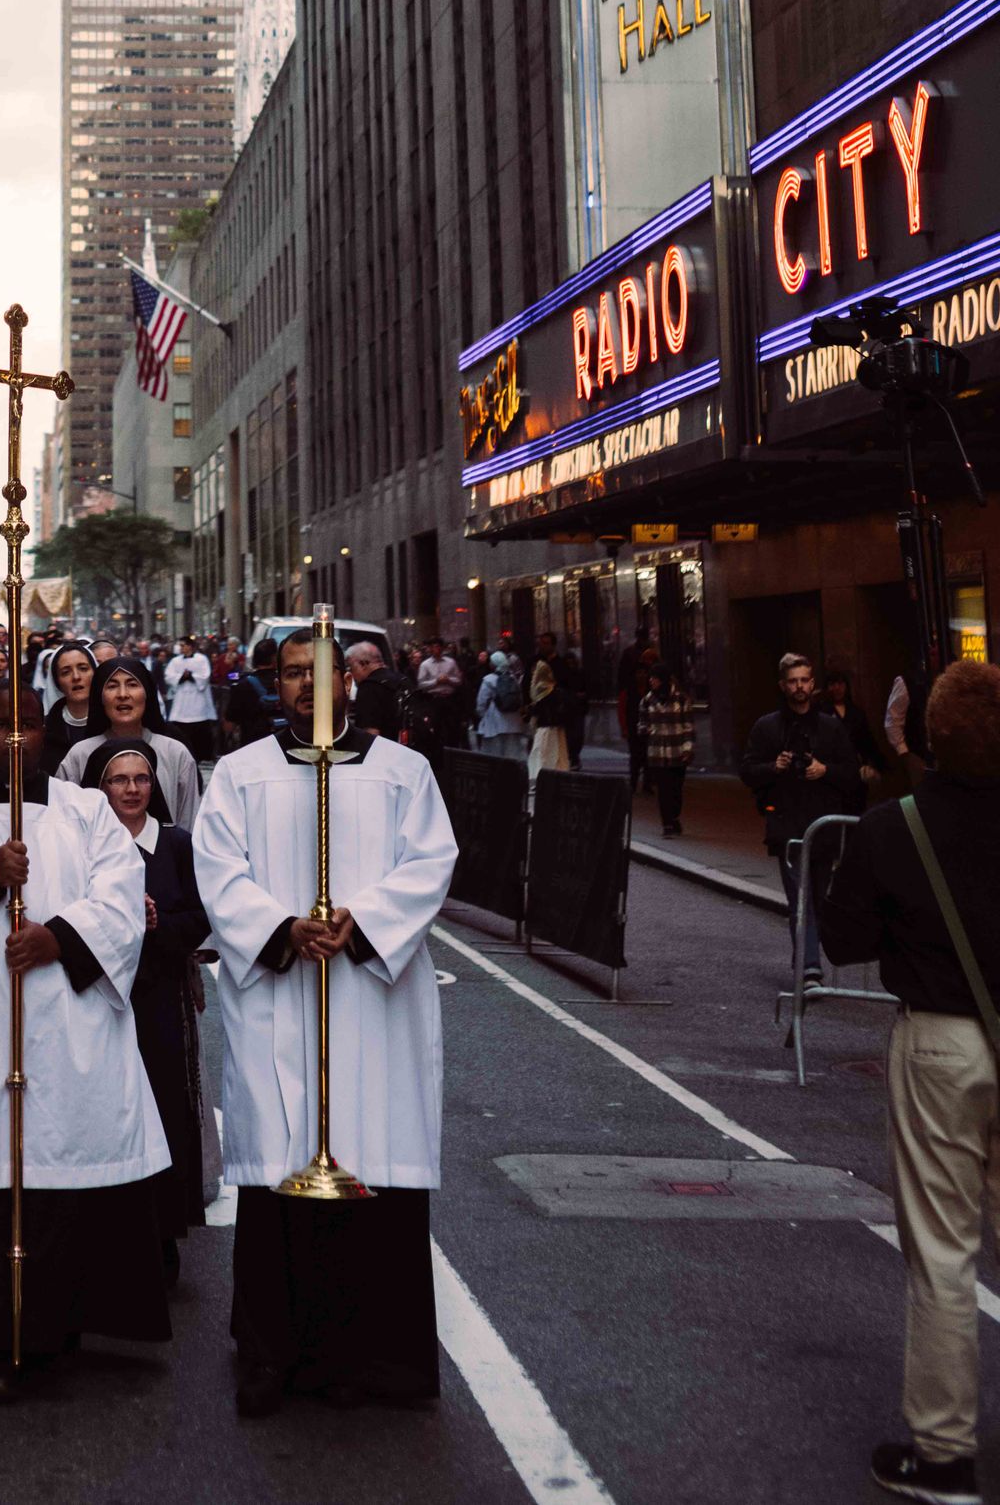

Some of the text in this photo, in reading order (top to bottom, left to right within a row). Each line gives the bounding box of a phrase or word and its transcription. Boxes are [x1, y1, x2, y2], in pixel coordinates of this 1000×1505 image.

[773, 80, 932, 295] CITY
[572, 244, 689, 401] RADIO
[603, 406, 680, 471] SPECTACULAR
